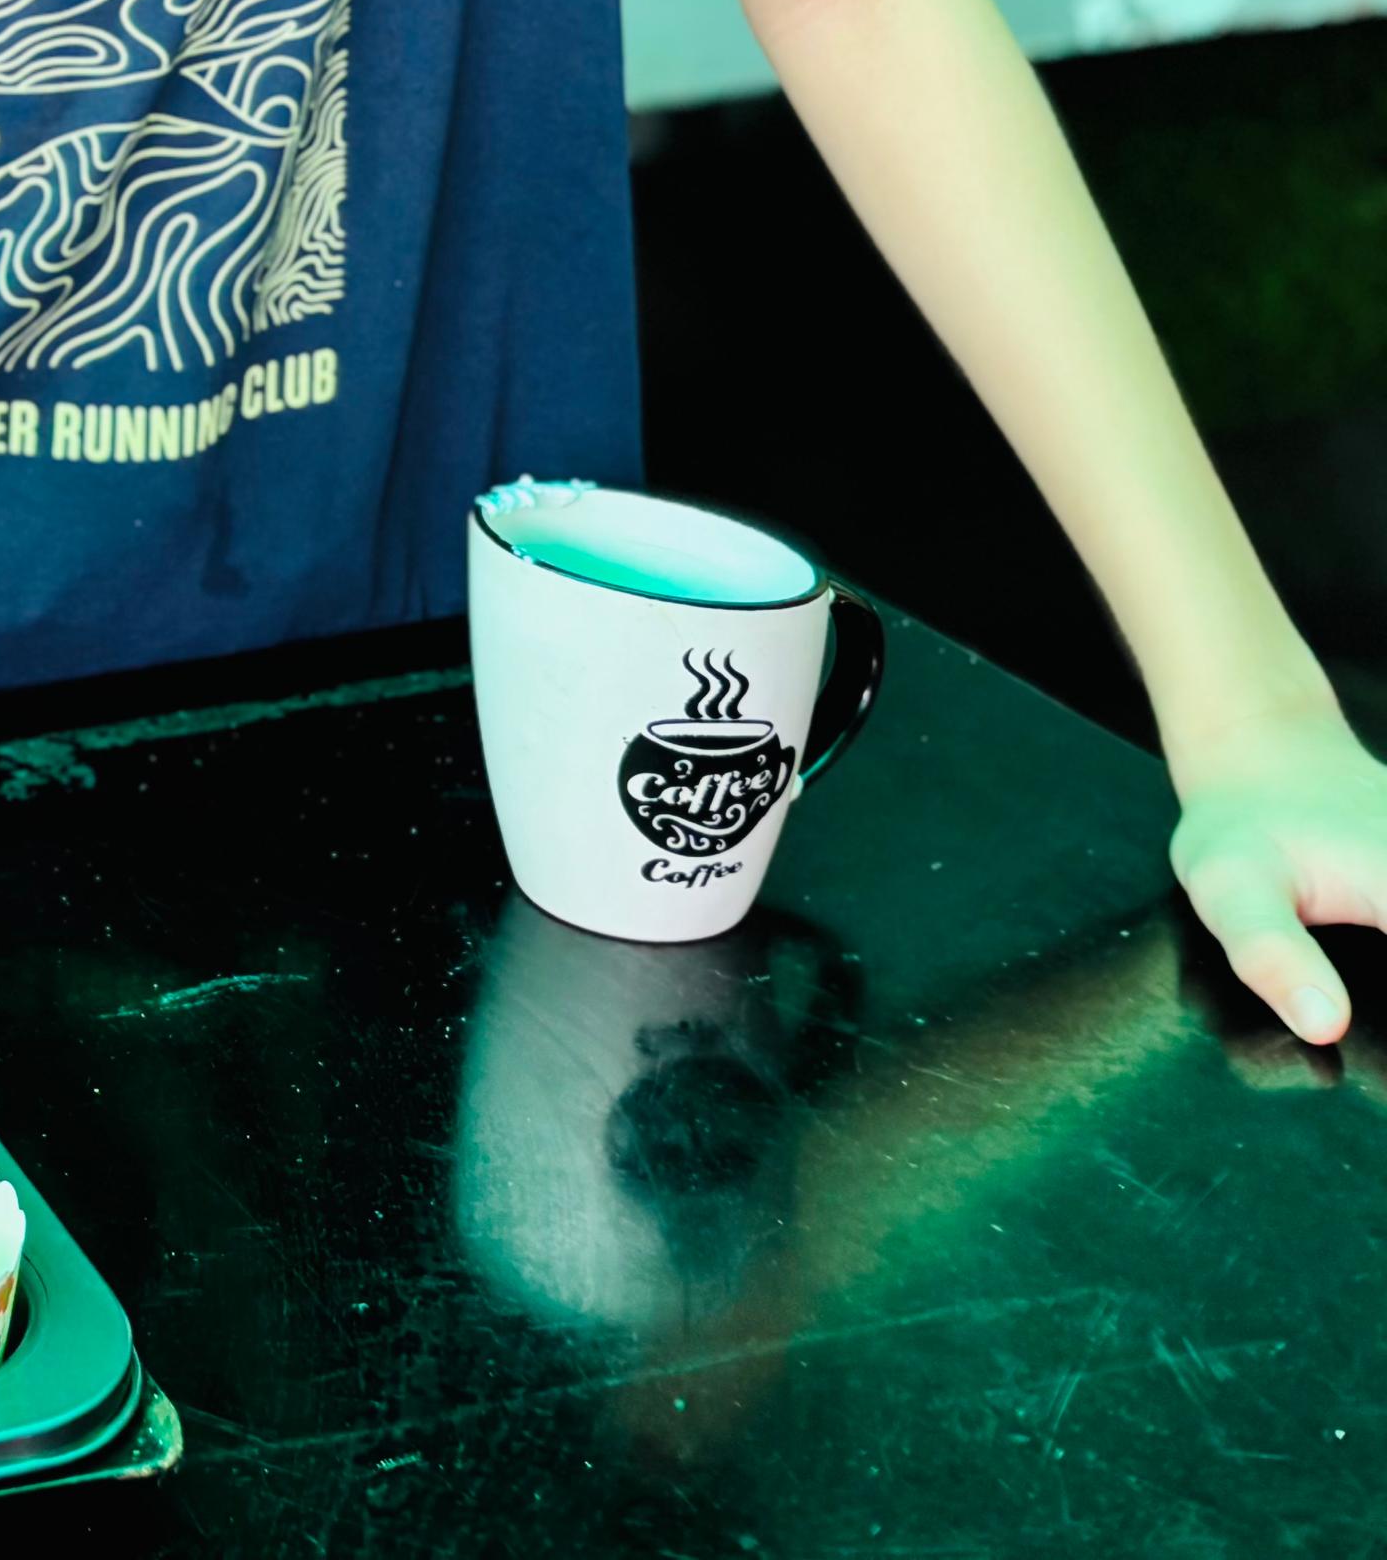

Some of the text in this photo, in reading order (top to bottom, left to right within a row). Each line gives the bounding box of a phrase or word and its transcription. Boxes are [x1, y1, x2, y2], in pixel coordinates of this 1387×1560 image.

[51, 382, 238, 463] RUNNING
[241, 347, 338, 420] CLUB
[627, 770, 773, 814] Coffee
[641, 858, 743, 888] Coffee
